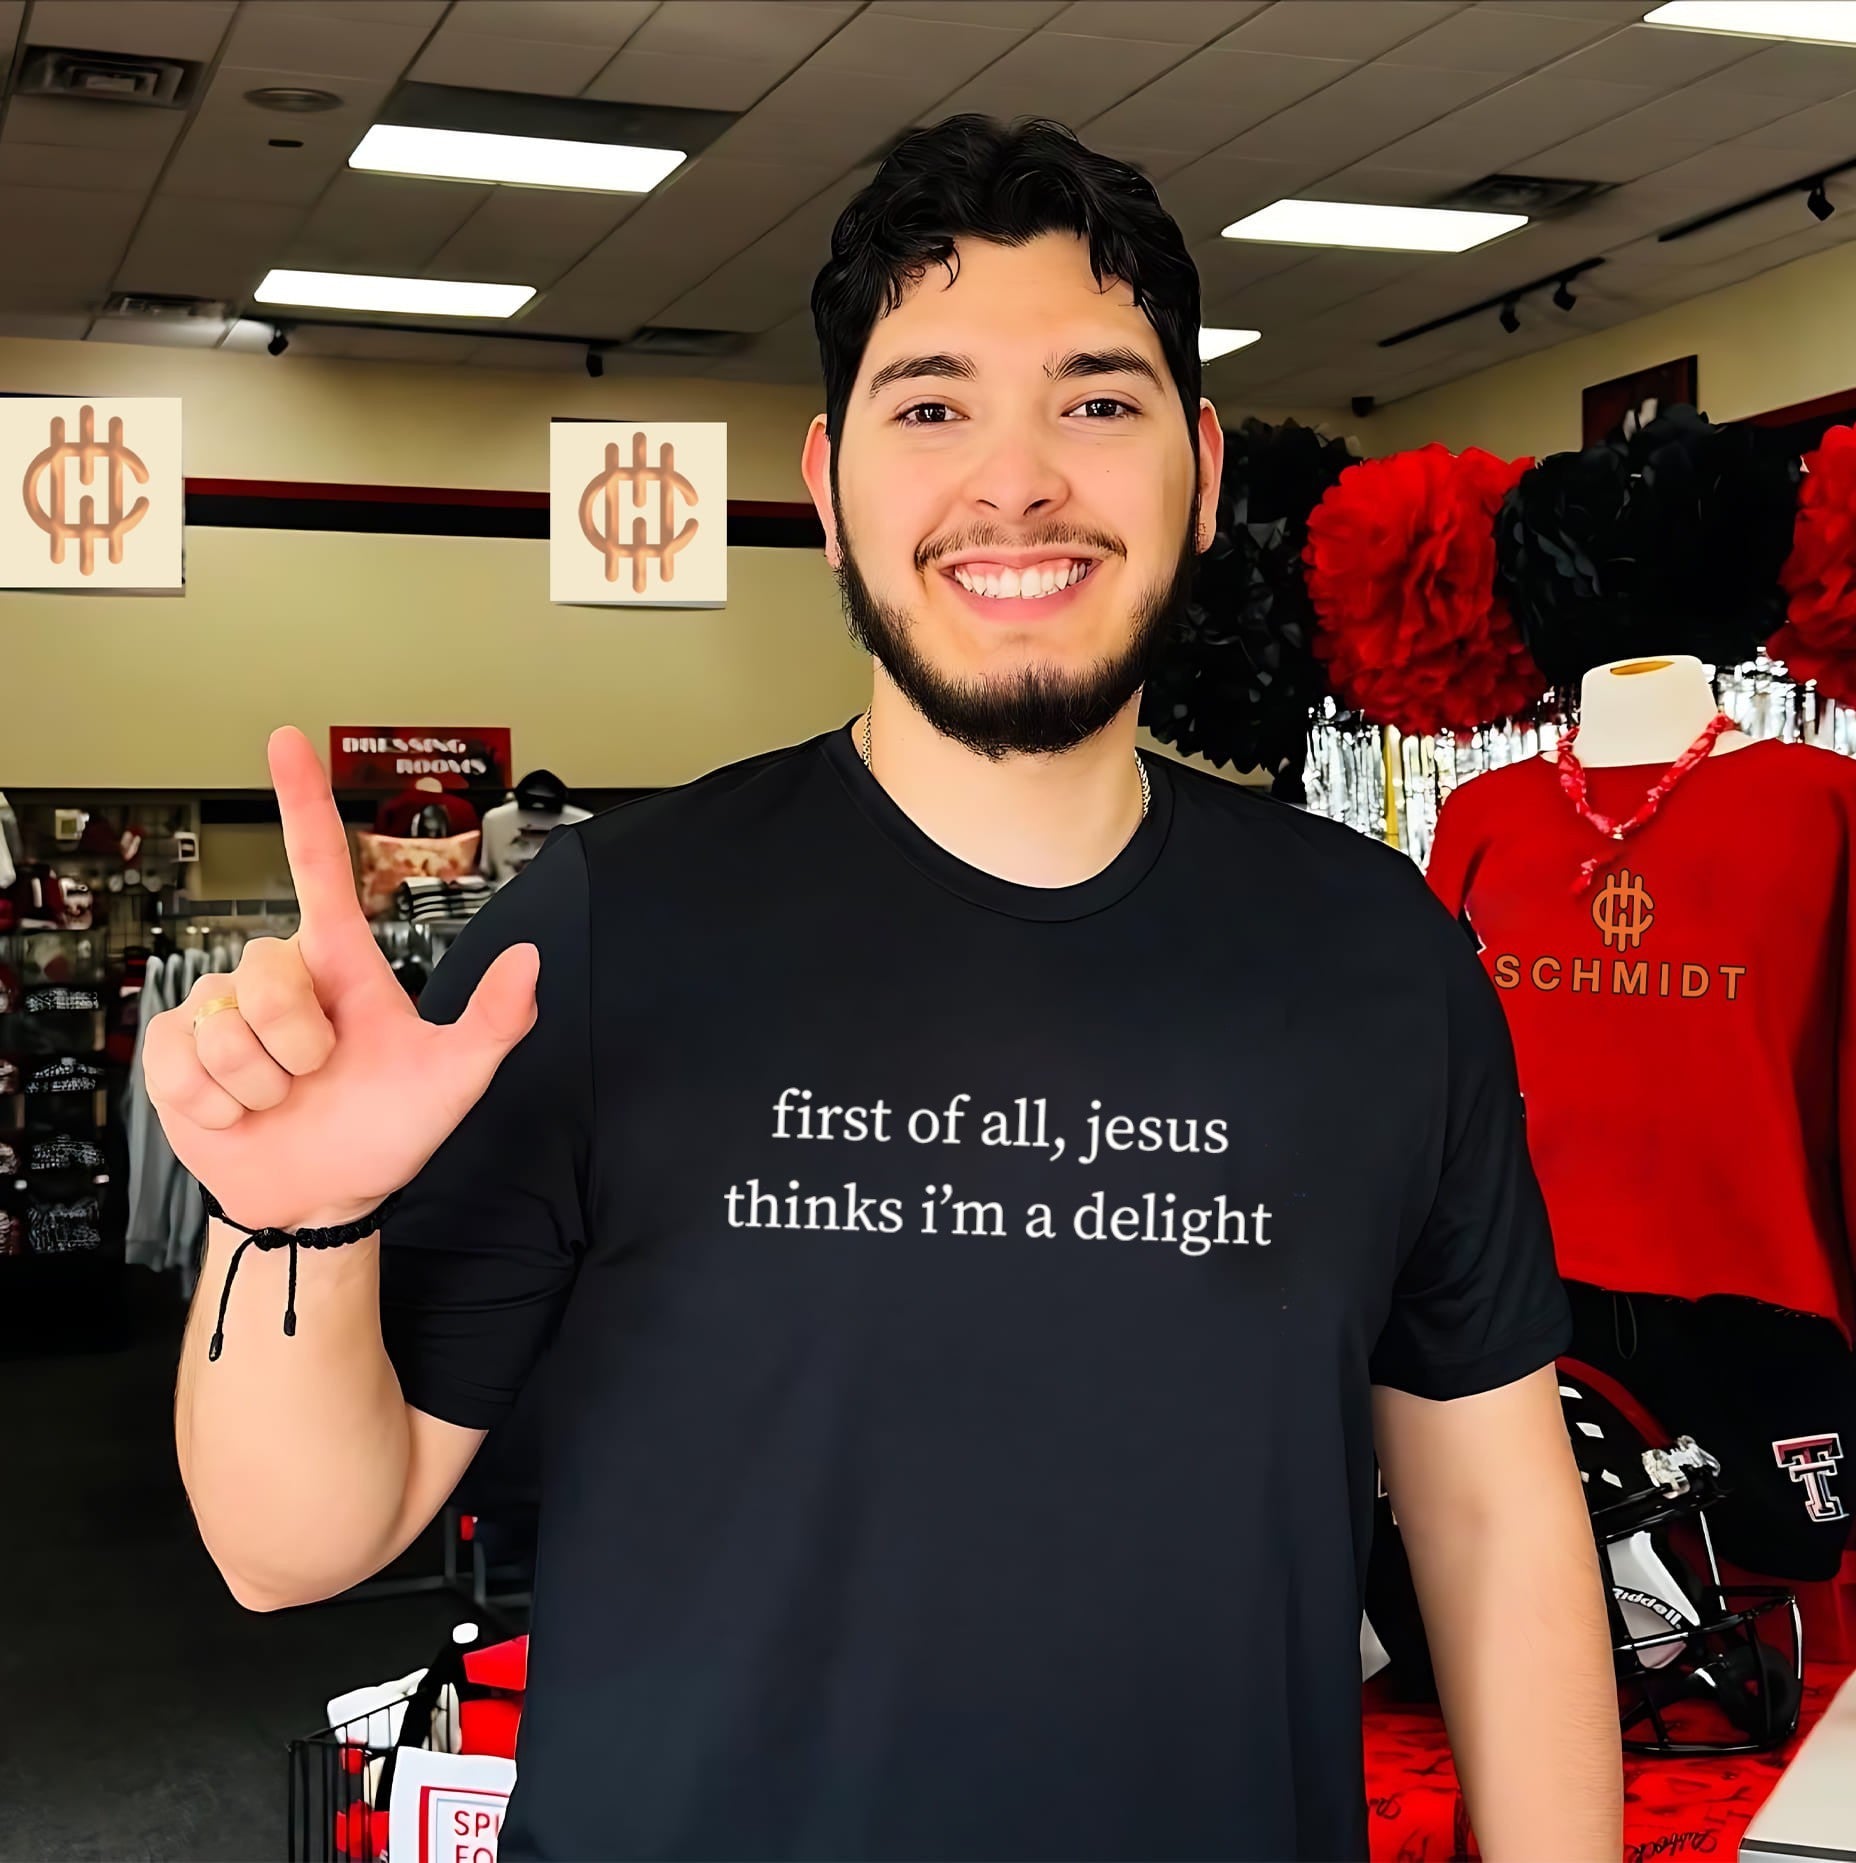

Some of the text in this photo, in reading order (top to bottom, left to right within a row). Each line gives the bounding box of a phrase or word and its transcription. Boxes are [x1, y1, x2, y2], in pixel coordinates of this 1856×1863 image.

[342, 737, 467, 753] DRESSING
[396, 758, 487, 775] ROOMS
[1494, 953, 1747, 1000] SCHMIDT
[771, 1087, 1229, 1165] first of all, jesus
[723, 1178, 904, 1234] thinks
[1025, 1203, 1057, 1239] a
[1073, 1190, 1273, 1257] delight
